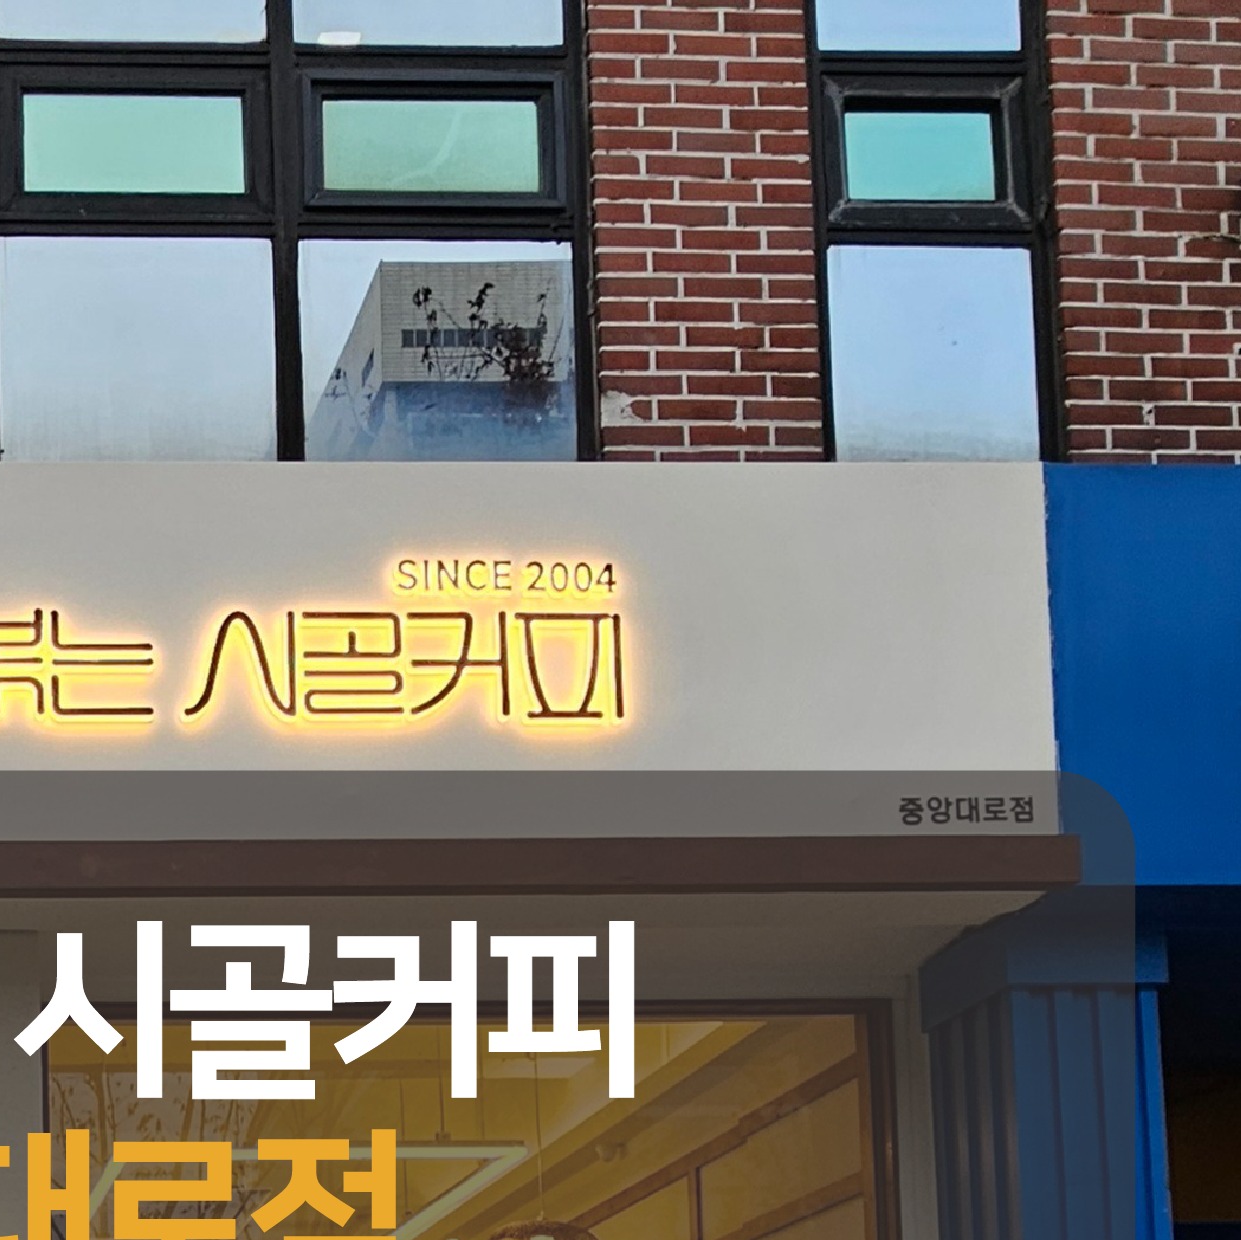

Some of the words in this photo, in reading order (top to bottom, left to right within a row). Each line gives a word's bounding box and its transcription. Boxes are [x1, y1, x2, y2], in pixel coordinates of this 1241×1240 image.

[397, 560, 513, 592] SINCE
[526, 563, 618, 594] 2004
[184, 610, 626, 720] 시골커피
[898, 796, 1035, 826] 중앙대로점
